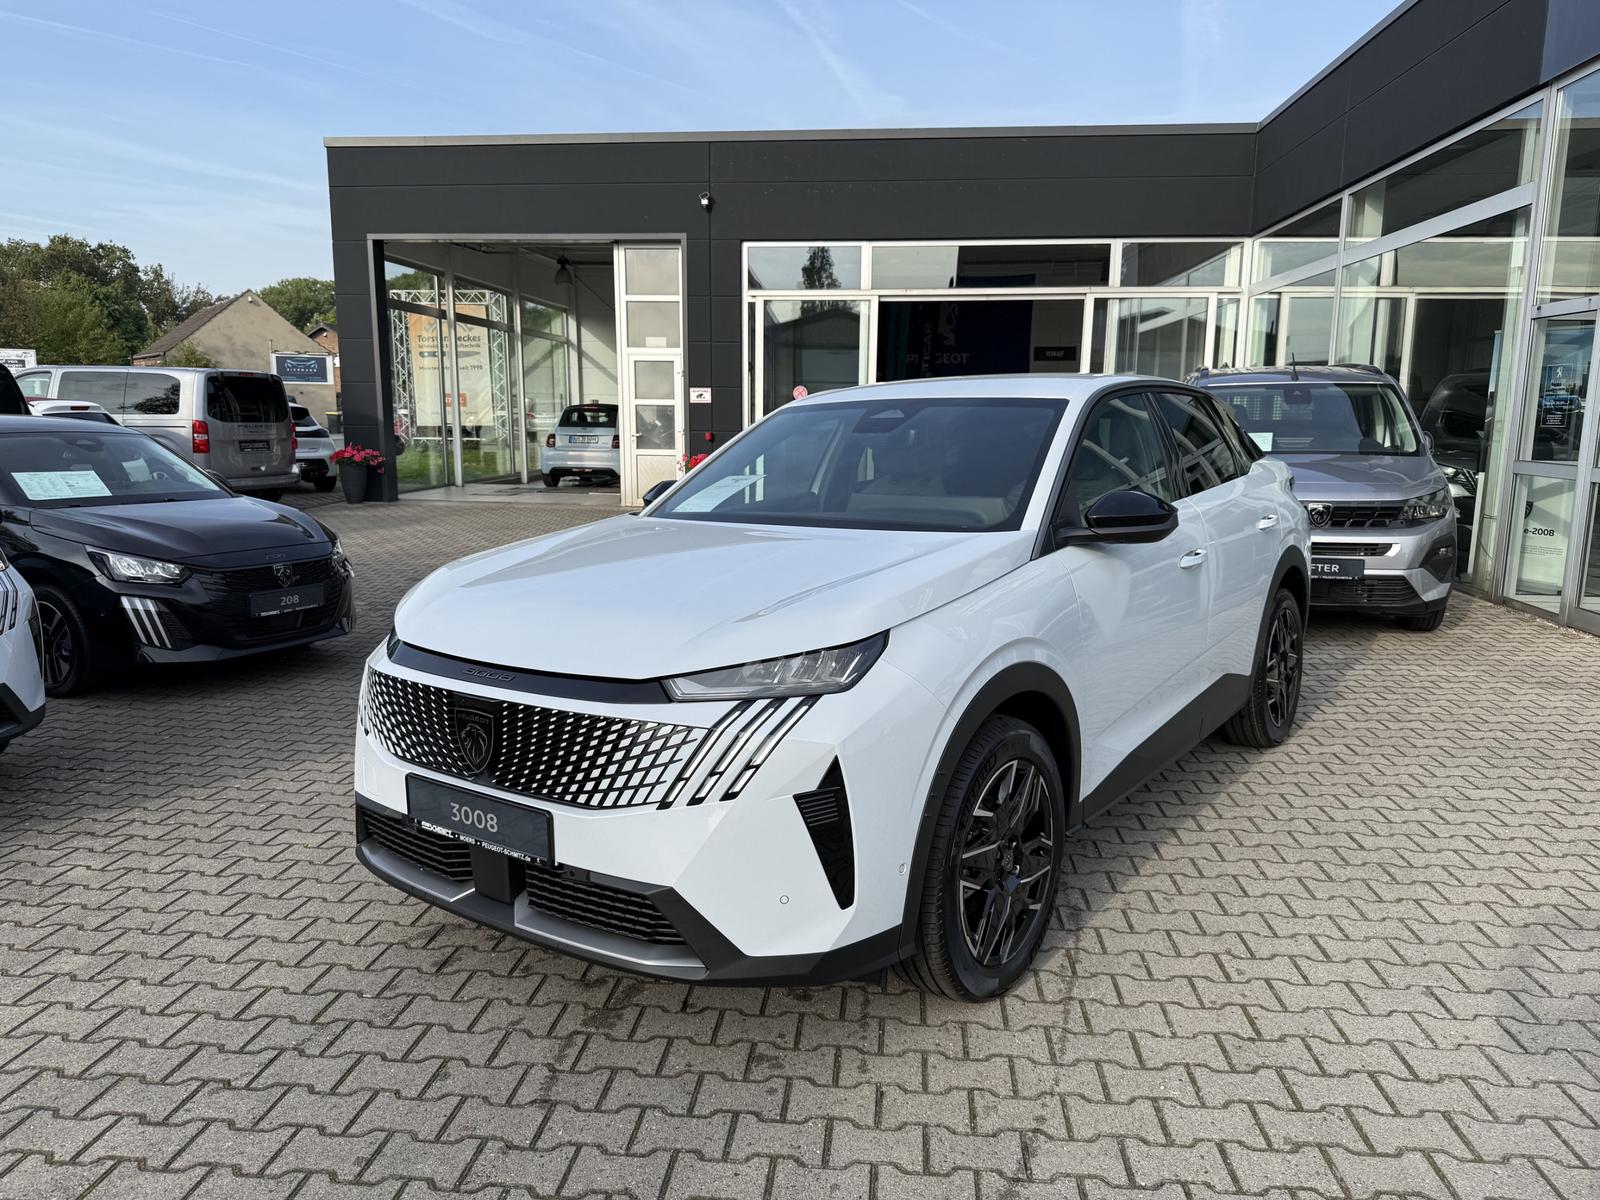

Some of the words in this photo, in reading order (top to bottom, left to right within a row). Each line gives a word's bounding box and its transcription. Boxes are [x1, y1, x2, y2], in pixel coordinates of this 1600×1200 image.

[1524, 528, 1555, 536] e-2008
[1311, 563, 1340, 573] FTER
[280, 594, 300, 606] 208
[463, 667, 516, 681] 3008
[450, 802, 498, 832] 3008
[459, 834, 476, 845] MOERS
